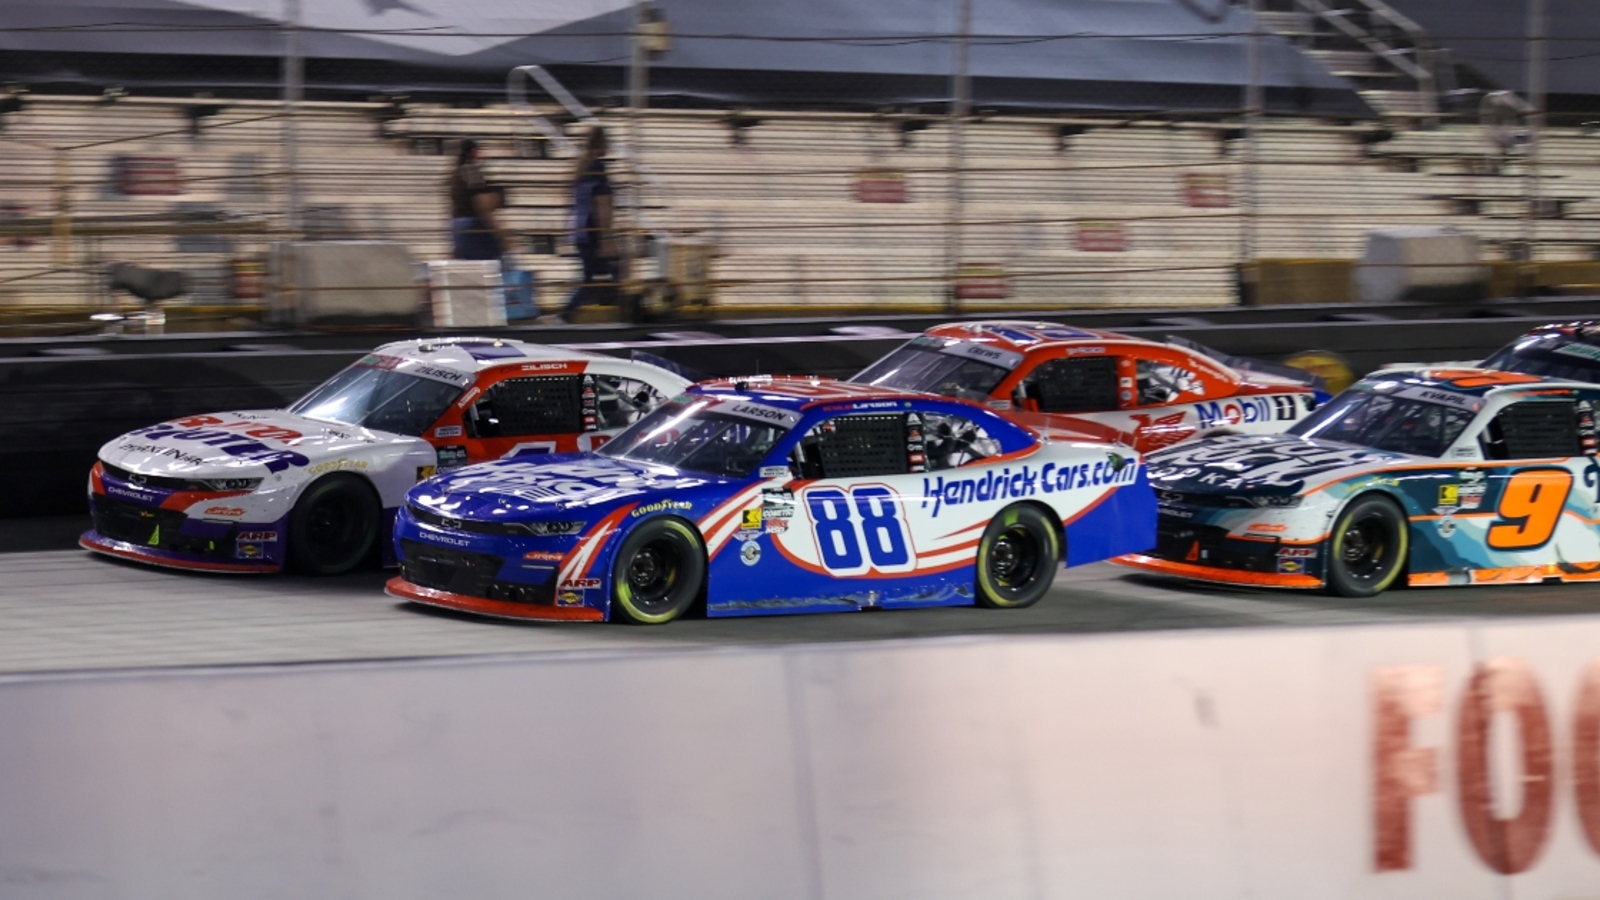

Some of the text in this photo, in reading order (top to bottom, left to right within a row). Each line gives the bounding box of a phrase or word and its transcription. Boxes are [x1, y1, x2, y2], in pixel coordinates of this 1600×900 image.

[1419, 390, 1466, 405] KVAPIL
[732, 404, 787, 420] LARSON
[1194, 397, 1271, 429] Mobil
[108, 486, 155, 501] CHEVROLET
[631, 499, 693, 517] GOODYEAR
[1485, 467, 1573, 551] 9
[804, 486, 910, 570] 88
[238, 532, 277, 541] ARP
[419, 532, 470, 547] CHEVROLET
[560, 579, 600, 588] ARP
[1370, 655, 1600, 877] FO
